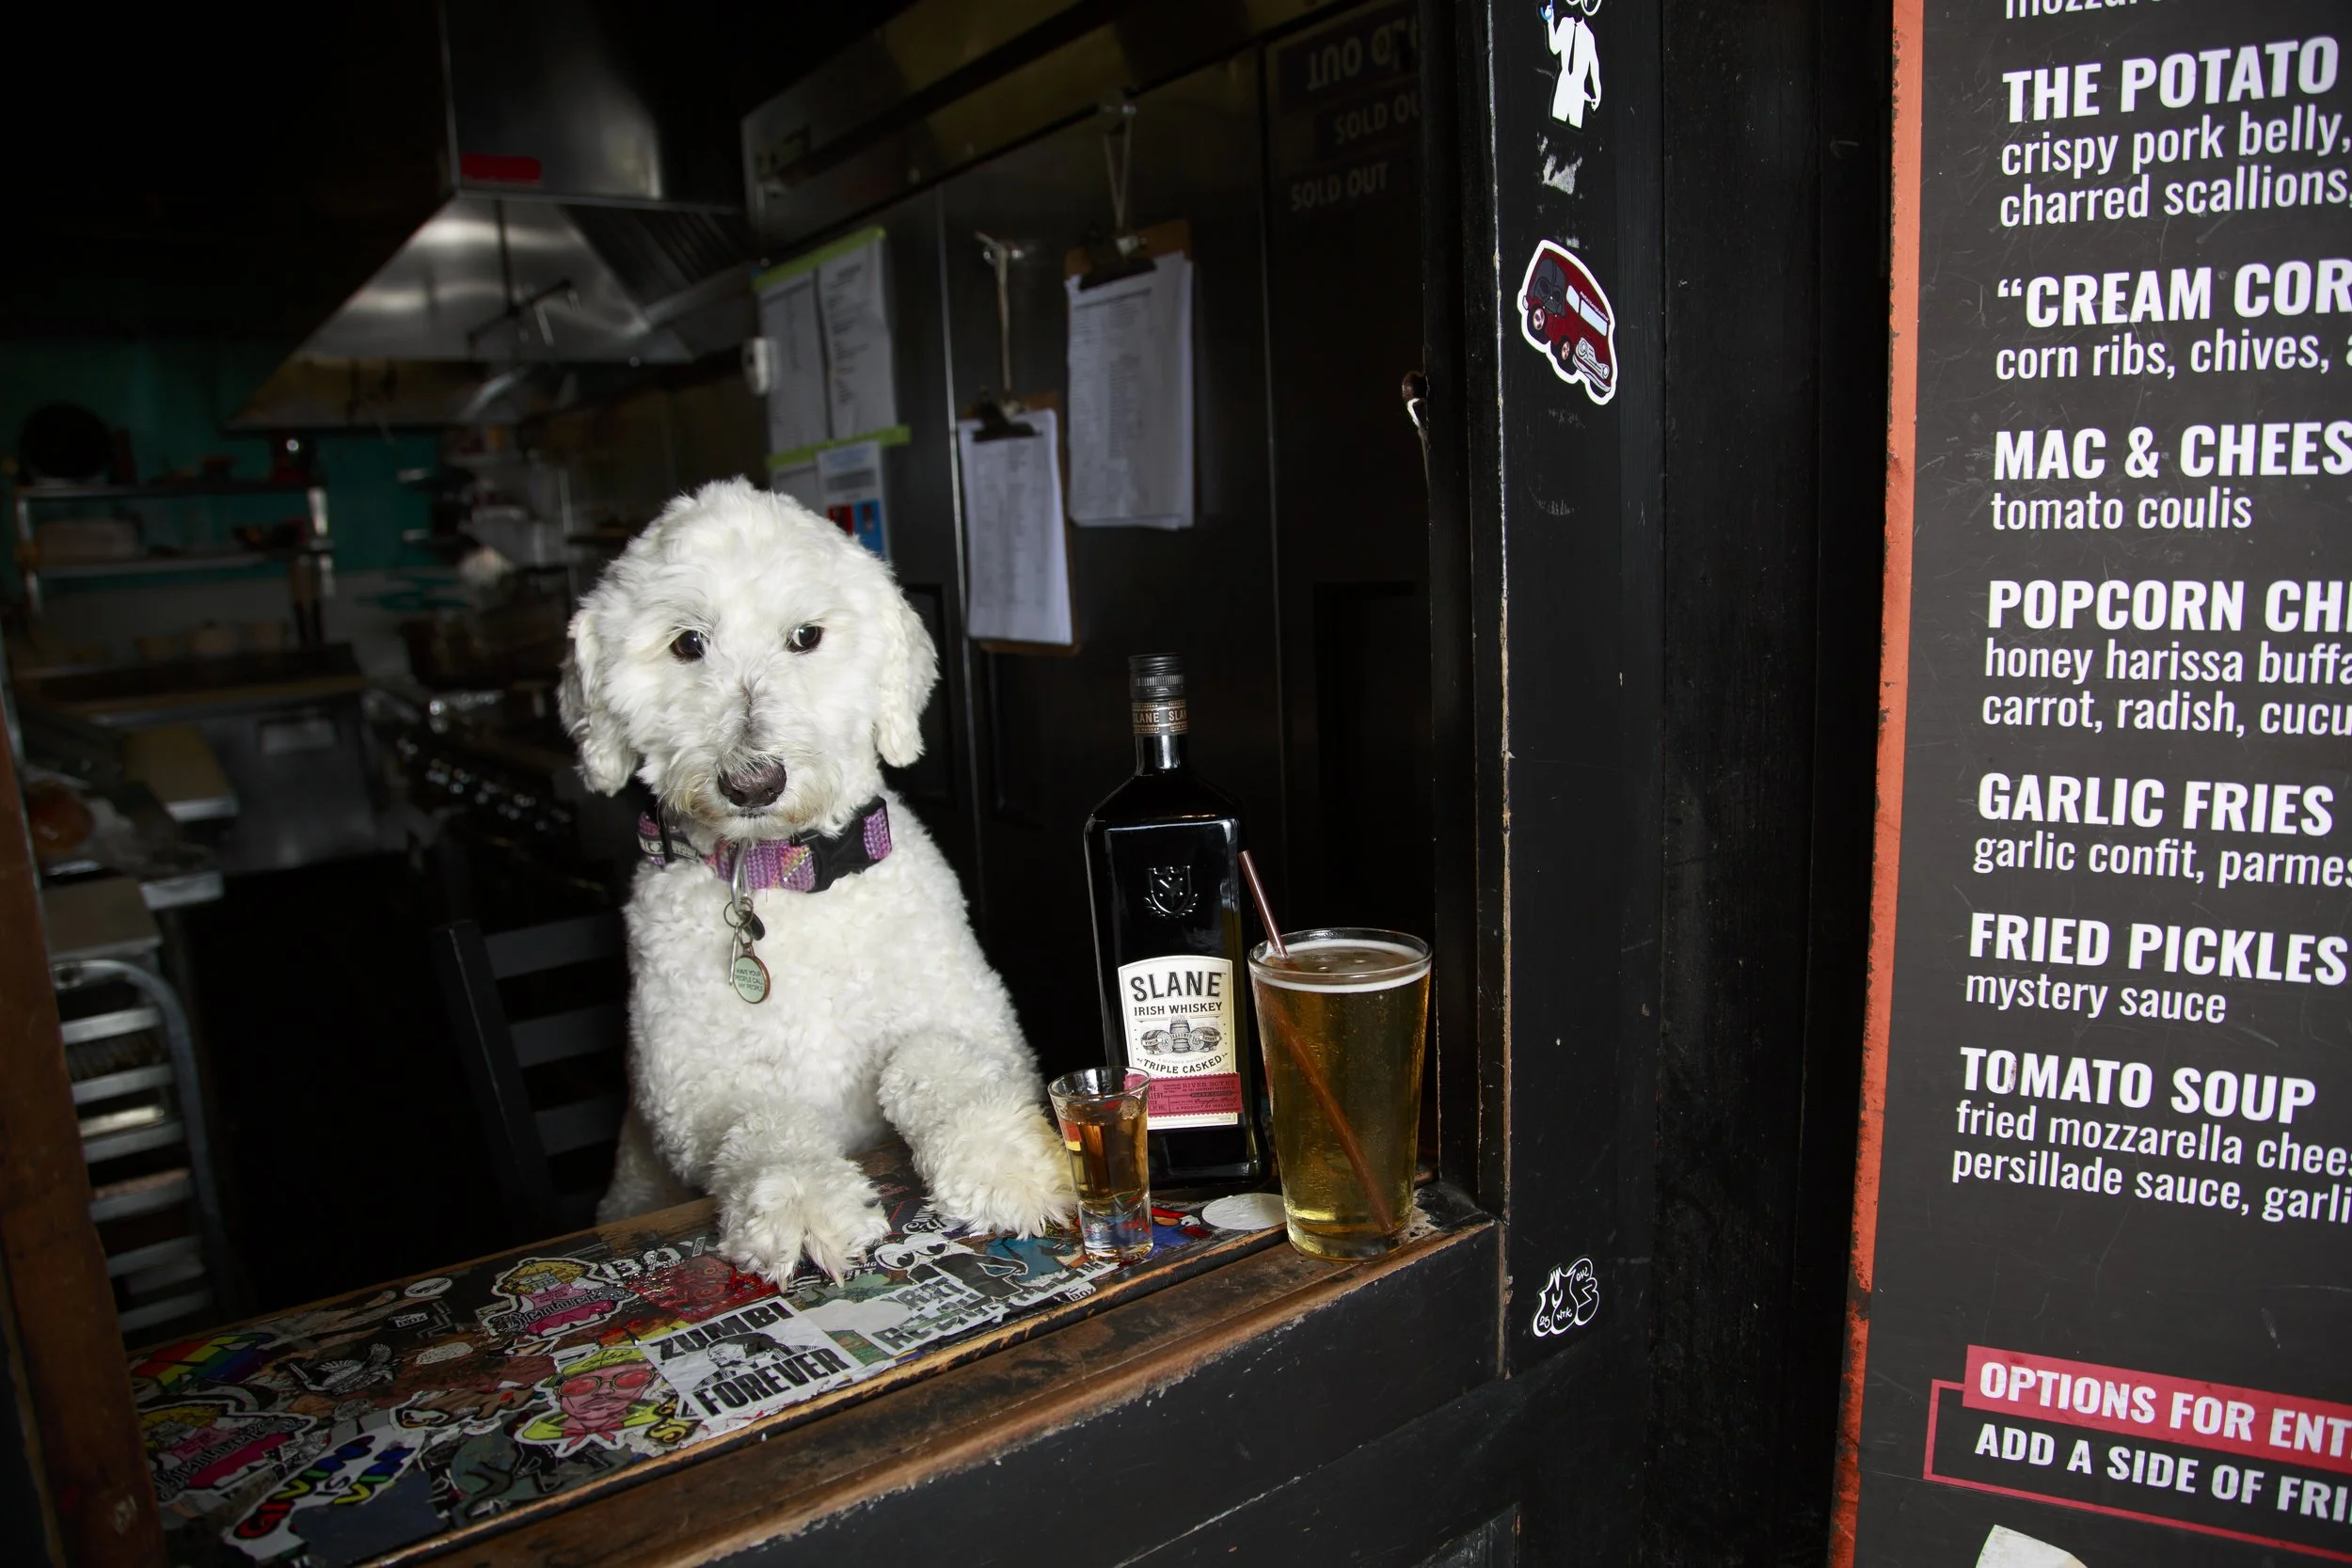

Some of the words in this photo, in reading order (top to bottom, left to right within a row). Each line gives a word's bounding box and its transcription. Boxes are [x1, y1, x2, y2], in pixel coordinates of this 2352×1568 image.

[2002, 62, 2102, 123] THE
[2120, 37, 2339, 113] POTATO
[1333, 103, 1388, 145] SOLD
[2001, 131, 2120, 180] crispy
[2132, 114, 2225, 175] pork
[2238, 103, 2351, 157] belly,
[1290, 173, 1341, 213] SOLD
[1347, 161, 1389, 198] OUT
[2000, 173, 2150, 228] charred
[1995, 345, 2078, 381] corn
[2092, 331, 2175, 380] ribs,
[2190, 327, 2329, 374] chives,
[1994, 427, 2106, 481] MAC
[2124, 425, 2159, 479] &
[1990, 490, 2123, 531] tomato
[2137, 485, 2252, 531] coulis
[1988, 579, 2245, 632] POPCORN
[2265, 579, 2352, 633] CH
[1985, 636, 2094, 686] honey
[2106, 638, 2244, 683] harissa
[1982, 689, 2103, 734] carrot,
[2117, 689, 2245, 738] radish,
[1978, 772, 2165, 828] GARLIC
[2183, 780, 2334, 837] FRIES
[1972, 830, 2075, 874] garlic
[2088, 837, 2204, 884] confit,
[1969, 911, 2110, 967] FRIED
[2127, 923, 2348, 986] PICKLES
[1131, 971, 1222, 1002] SLANE
[1134, 1006, 1165, 1016] IRISH
[1169, 1002, 1222, 1014] WHISKEY
[1965, 973, 2109, 1019] mystery
[2119, 987, 2227, 1024] sauce
[1144, 1058, 1179, 1074] TRIPLE
[1183, 1055, 1222, 1073] CASKED
[1960, 1046, 2153, 1109] TOMATO
[2170, 1067, 2316, 1124] SOUP
[1956, 1099, 2037, 1142] fried
[2048, 1117, 2243, 1164] mozzarella
[2256, 1132, 2352, 1177] chee
[1951, 1149, 2122, 1196] persillade
[2134, 1171, 2249, 1216] sauce,
[649, 1301, 795, 1361] ZUMBI
[691, 1347, 850, 1418] FOREVER
[1979, 1361, 2157, 1424] OPTIONS
[2169, 1391, 2255, 1442] FOR
[2268, 1408, 2352, 1457] ENT
[1974, 1423, 2055, 1466] ADD
[2066, 1439, 2092, 1475] A
[2106, 1446, 2200, 1494] SIDE
[2211, 1465, 2265, 1504] OF
[2278, 1477, 2352, 1523] FRI
